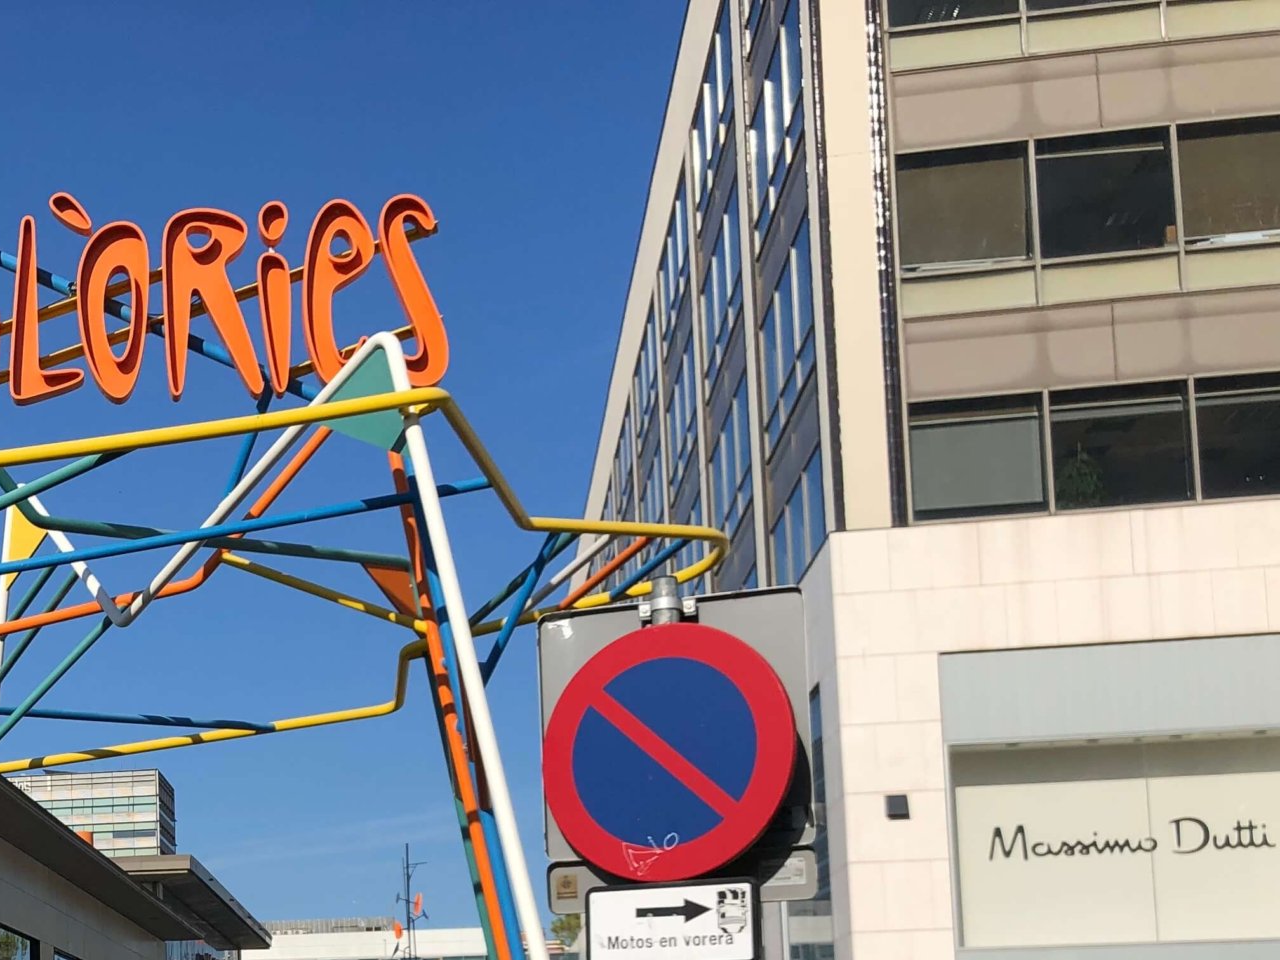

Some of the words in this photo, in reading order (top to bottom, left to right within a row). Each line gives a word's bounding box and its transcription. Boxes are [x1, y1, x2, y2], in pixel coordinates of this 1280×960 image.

[988, 824, 1158, 861] Massimo
[1168, 816, 1276, 854] Dutti
[607, 936, 653, 950] Motos
[659, 936, 677, 948] en
[683, 932, 734, 947] vorera
